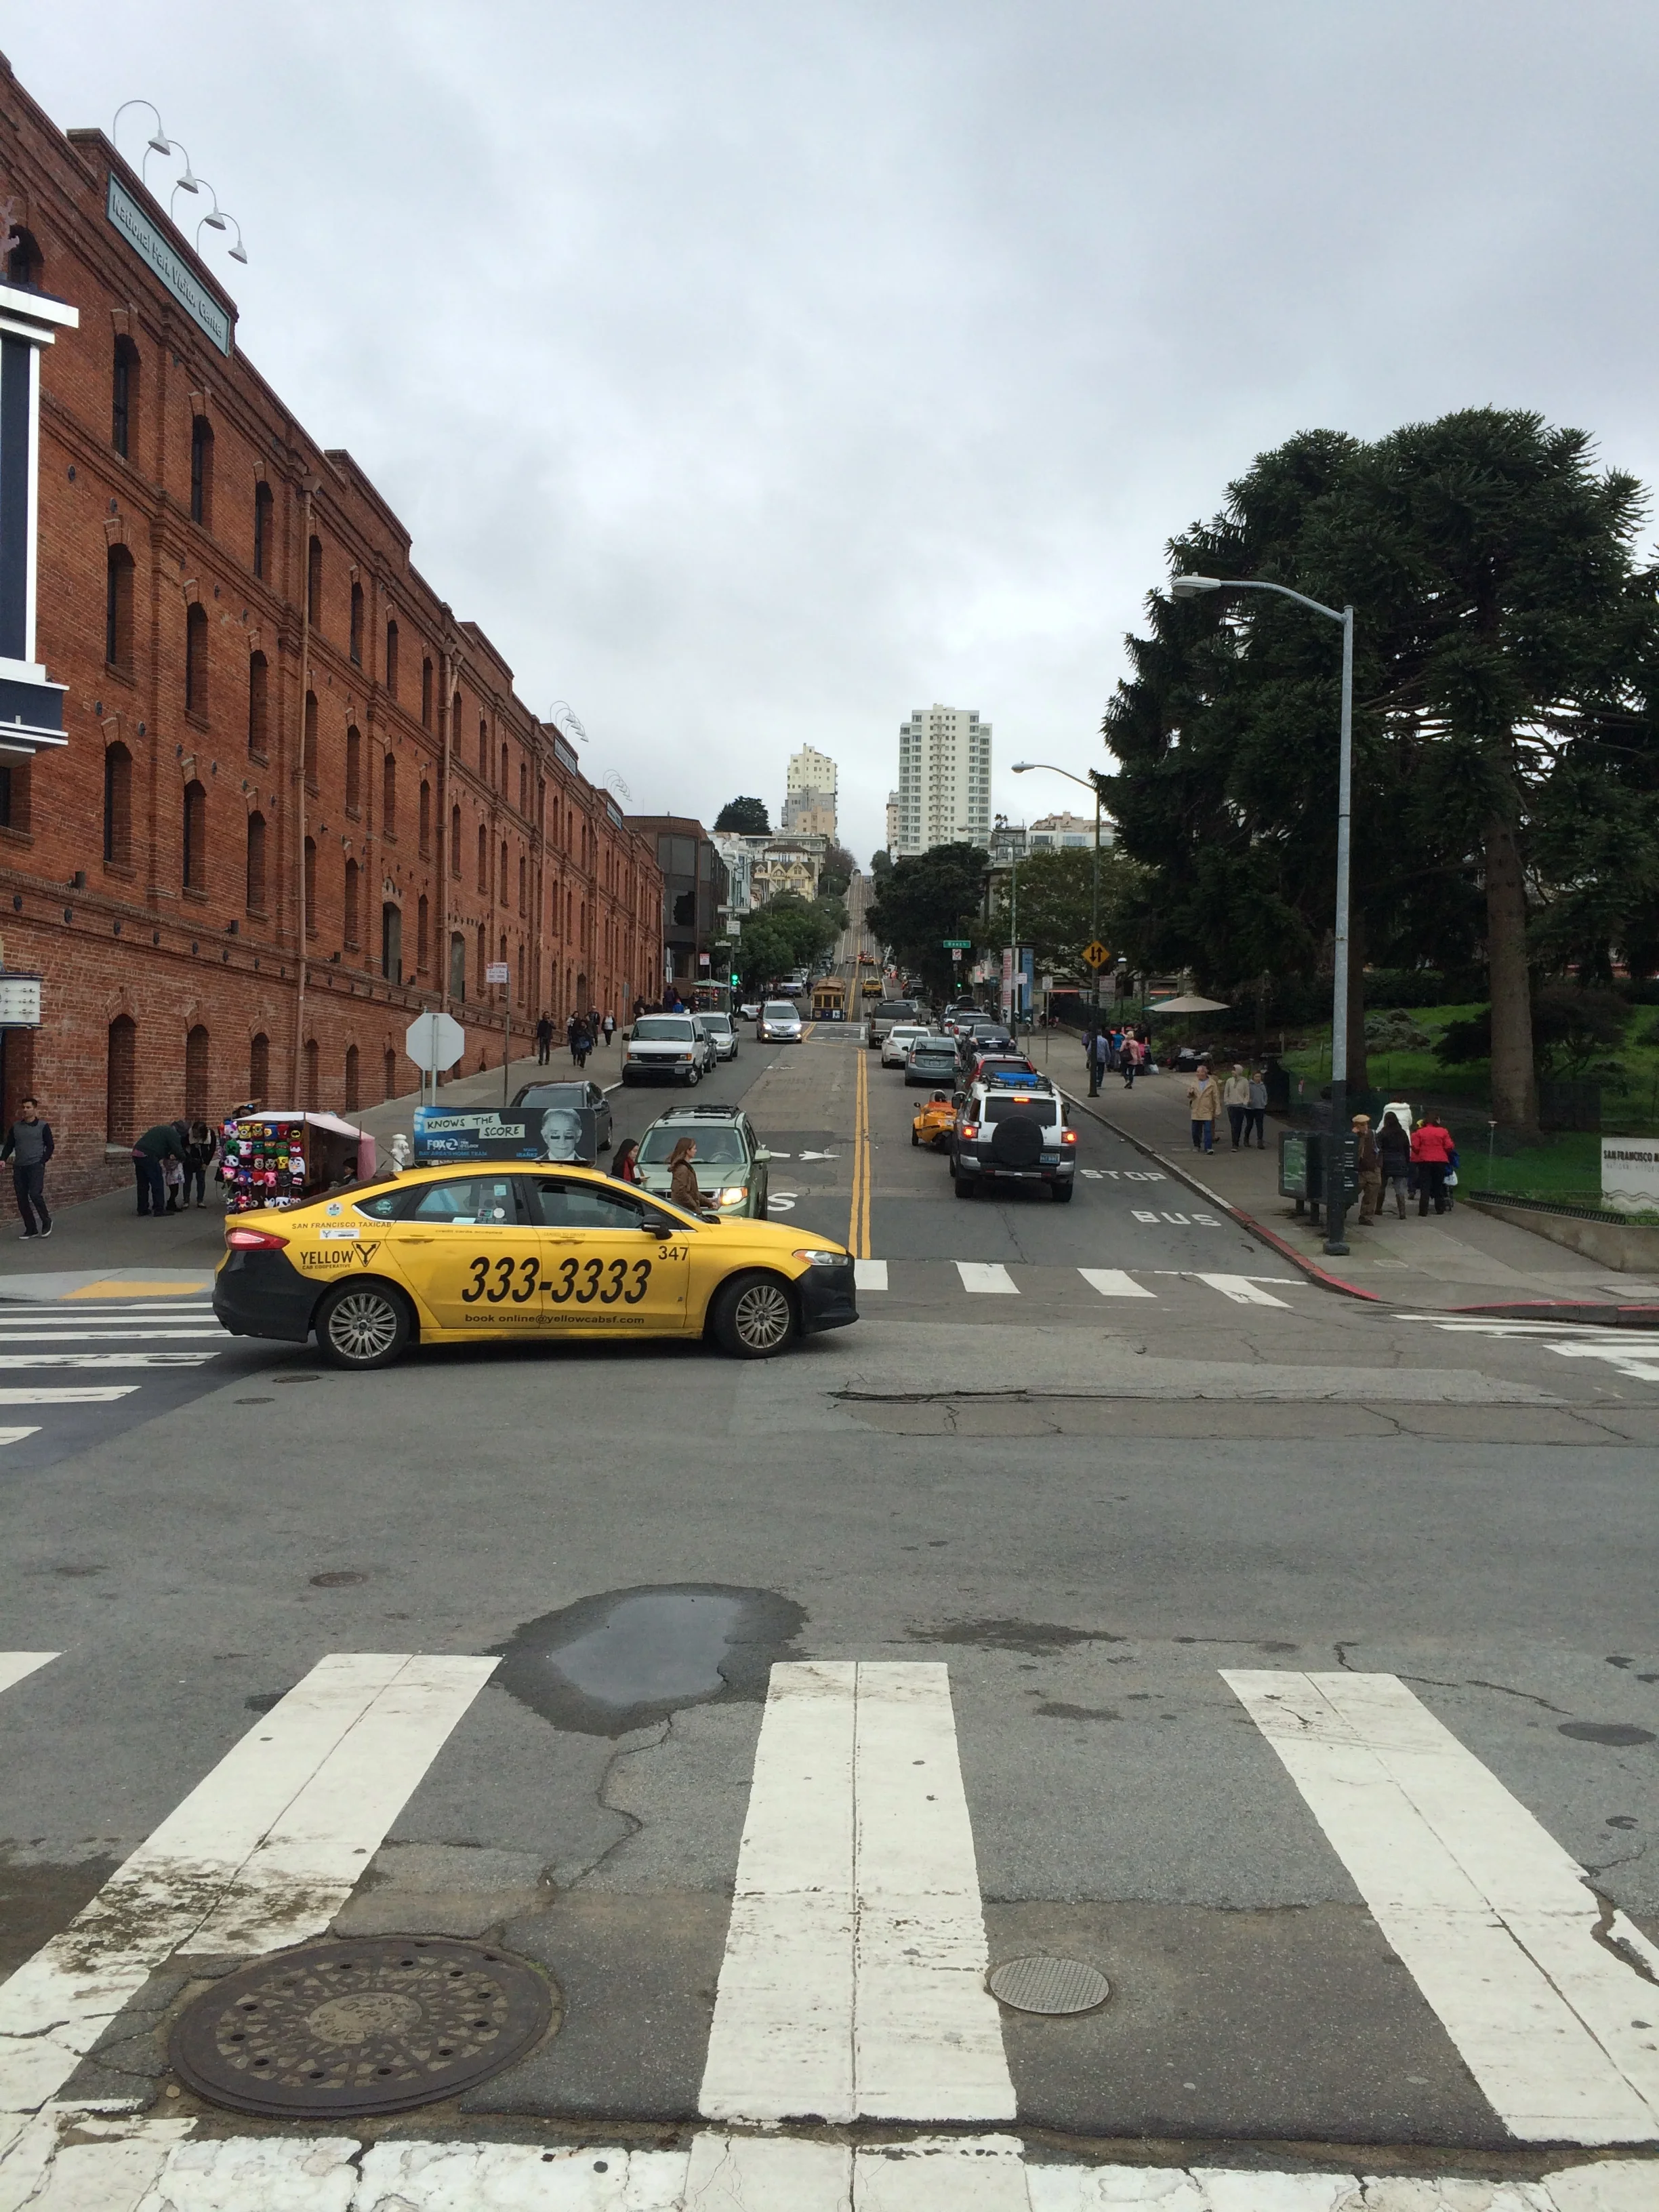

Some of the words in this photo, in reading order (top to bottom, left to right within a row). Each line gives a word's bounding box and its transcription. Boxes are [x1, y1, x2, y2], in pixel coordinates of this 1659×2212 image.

[112, 194, 150, 253] National
[172, 265, 198, 308] Visitor
[199, 300, 222, 339] Center
[427, 1118, 465, 1130] KNOWS
[474, 1116, 493, 1126] THE
[484, 1126, 520, 1137] SCORE
[427, 1139, 445, 1148] FOX
[1603, 1149, 1616, 1160] SAN
[1617, 1151, 1652, 1162] FRANCISCO
[1080, 1170, 1167, 1181] STOP
[1130, 1210, 1221, 1226] BUS
[300, 1250, 354, 1265] YELLOW
[658, 1246, 688, 1261] 347
[462, 1256, 652, 1304] 333-3333
